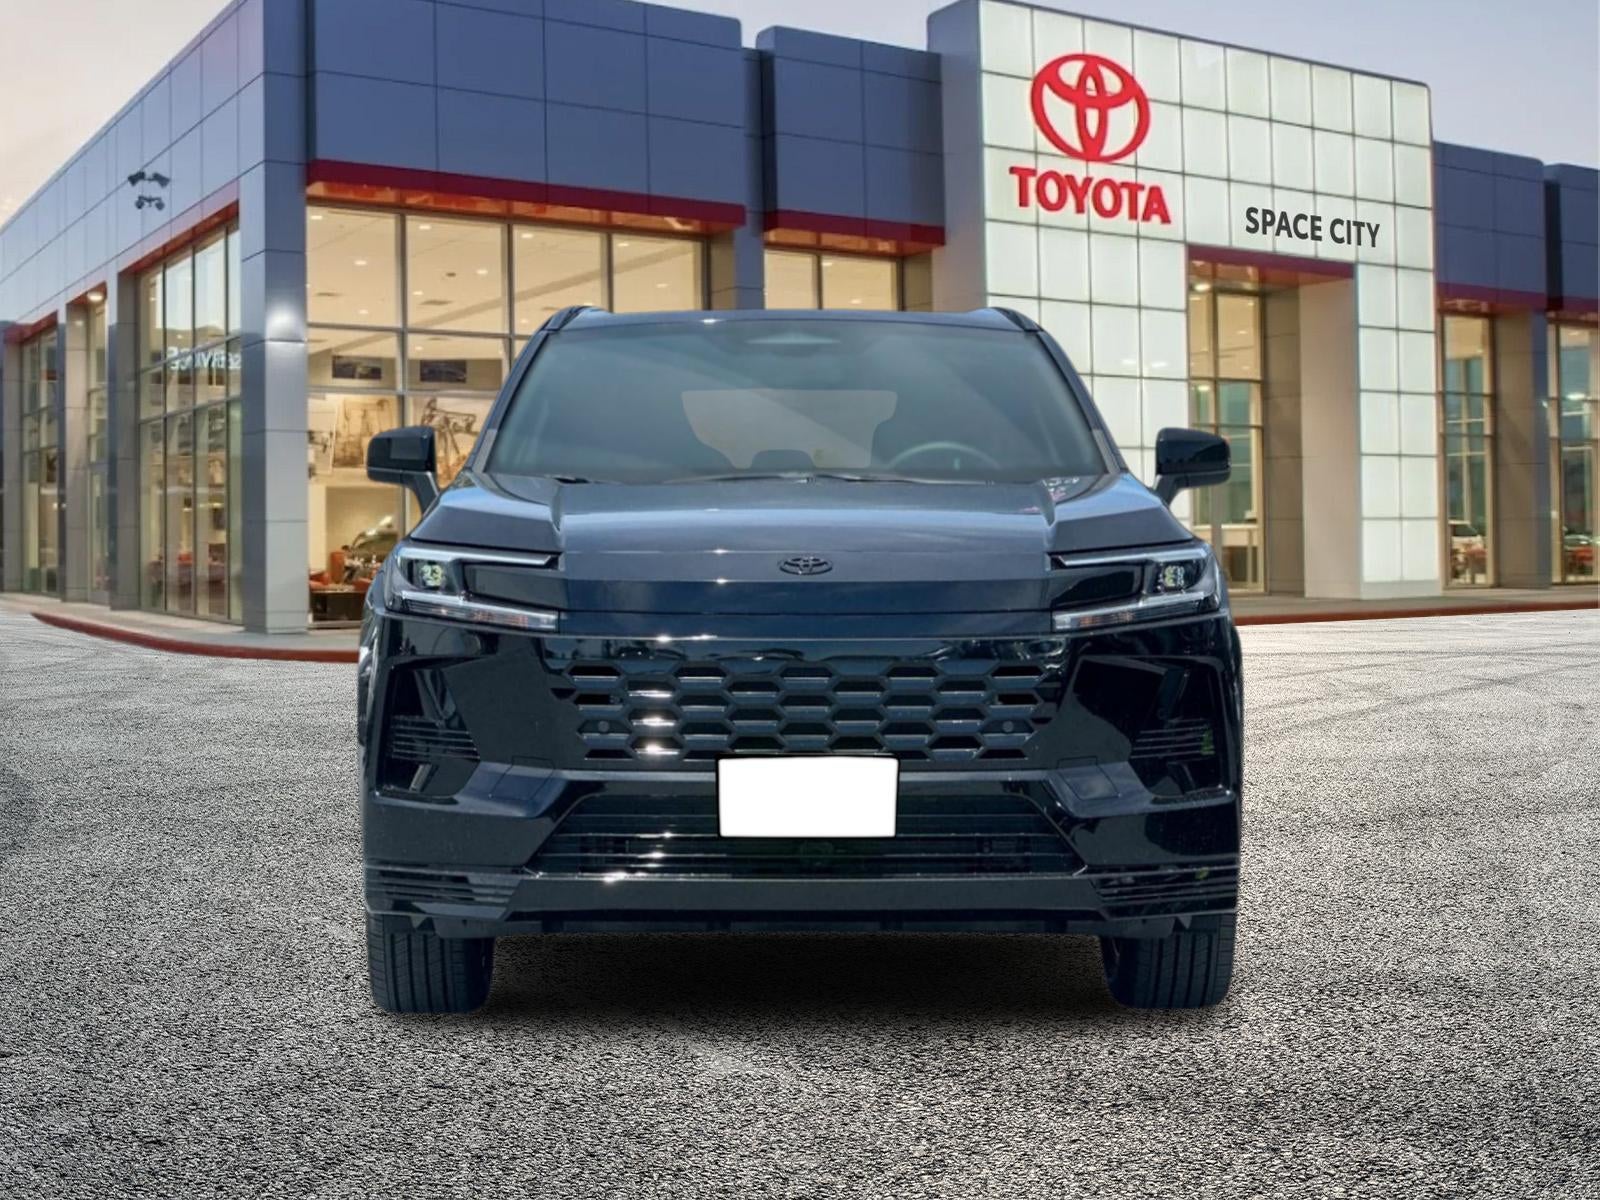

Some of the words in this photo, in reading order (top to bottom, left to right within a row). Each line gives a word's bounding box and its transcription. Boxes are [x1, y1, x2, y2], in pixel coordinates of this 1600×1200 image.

[1010, 166, 1171, 224] TOYOTA
[1245, 206, 1323, 242] SPACE
[1329, 218, 1381, 248] CITY
